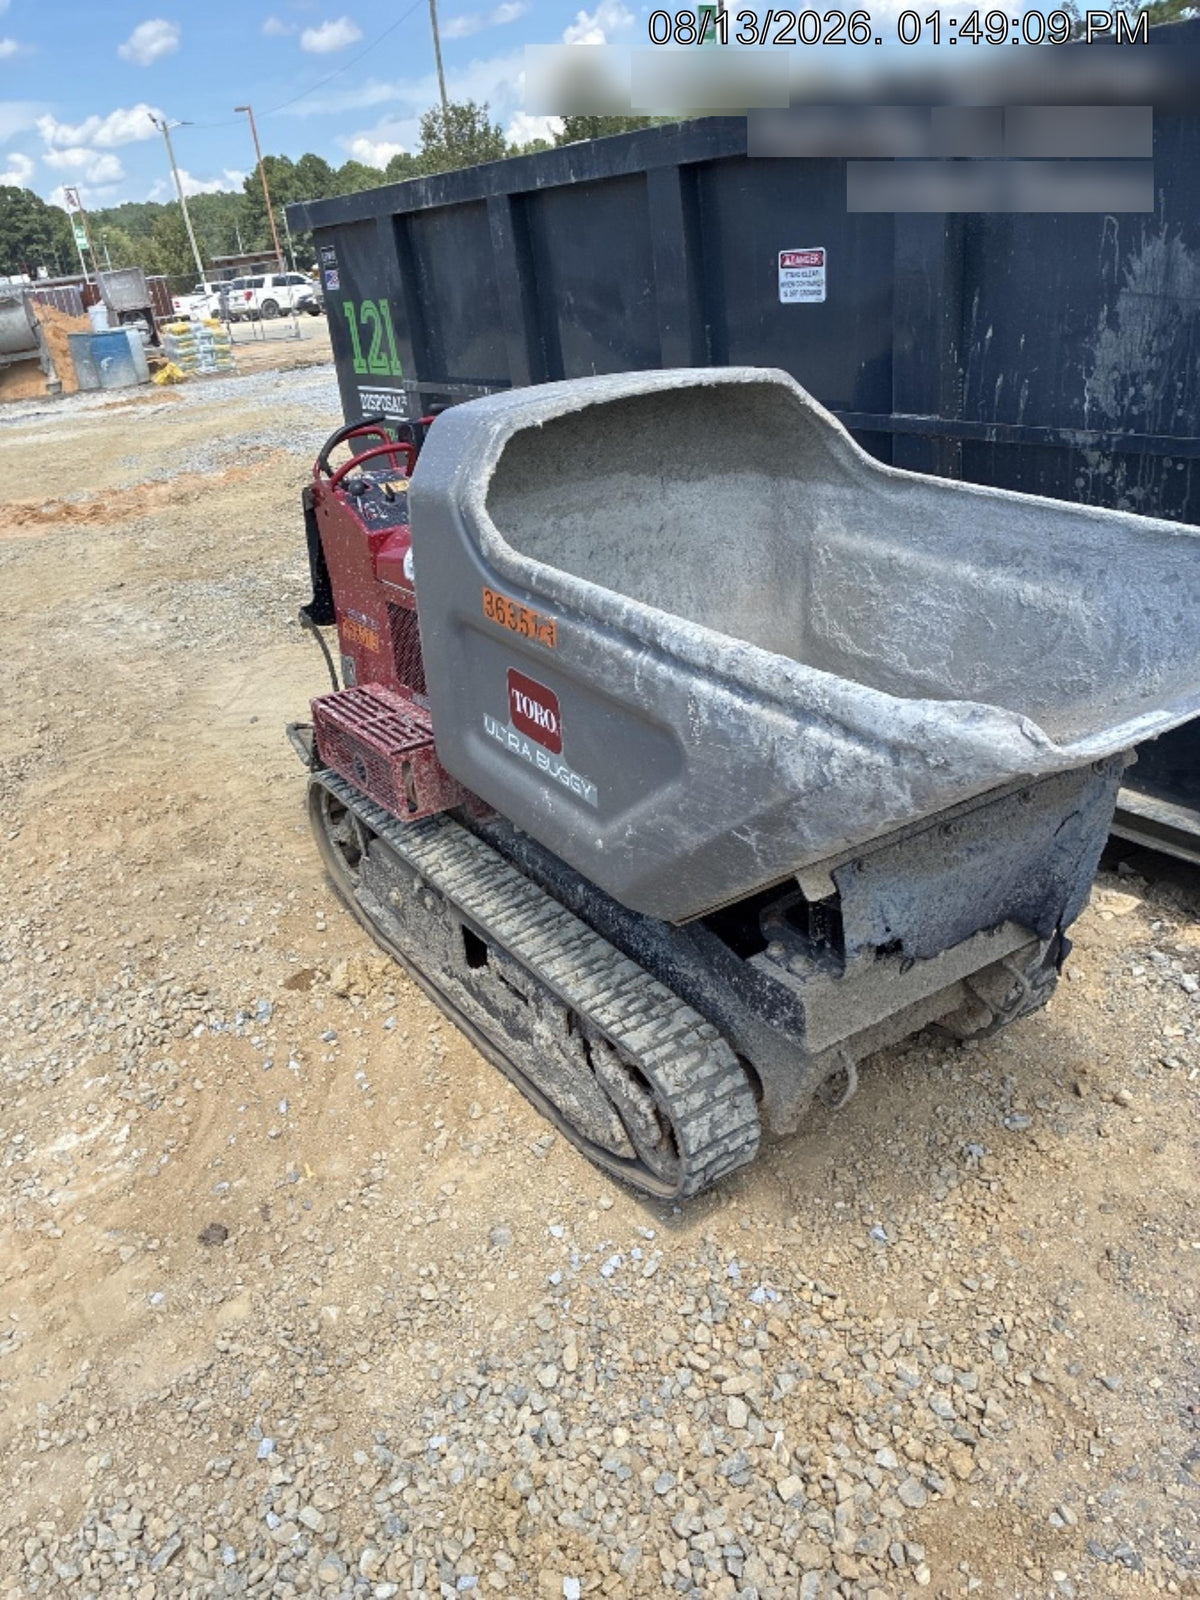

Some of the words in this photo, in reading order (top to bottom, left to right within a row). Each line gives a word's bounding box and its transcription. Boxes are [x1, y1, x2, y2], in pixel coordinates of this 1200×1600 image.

[343, 298, 402, 376] 121
[511, 688, 557, 734] TORO
[484, 713, 533, 763] ULTRA
[536, 750, 594, 799] BUGGY
